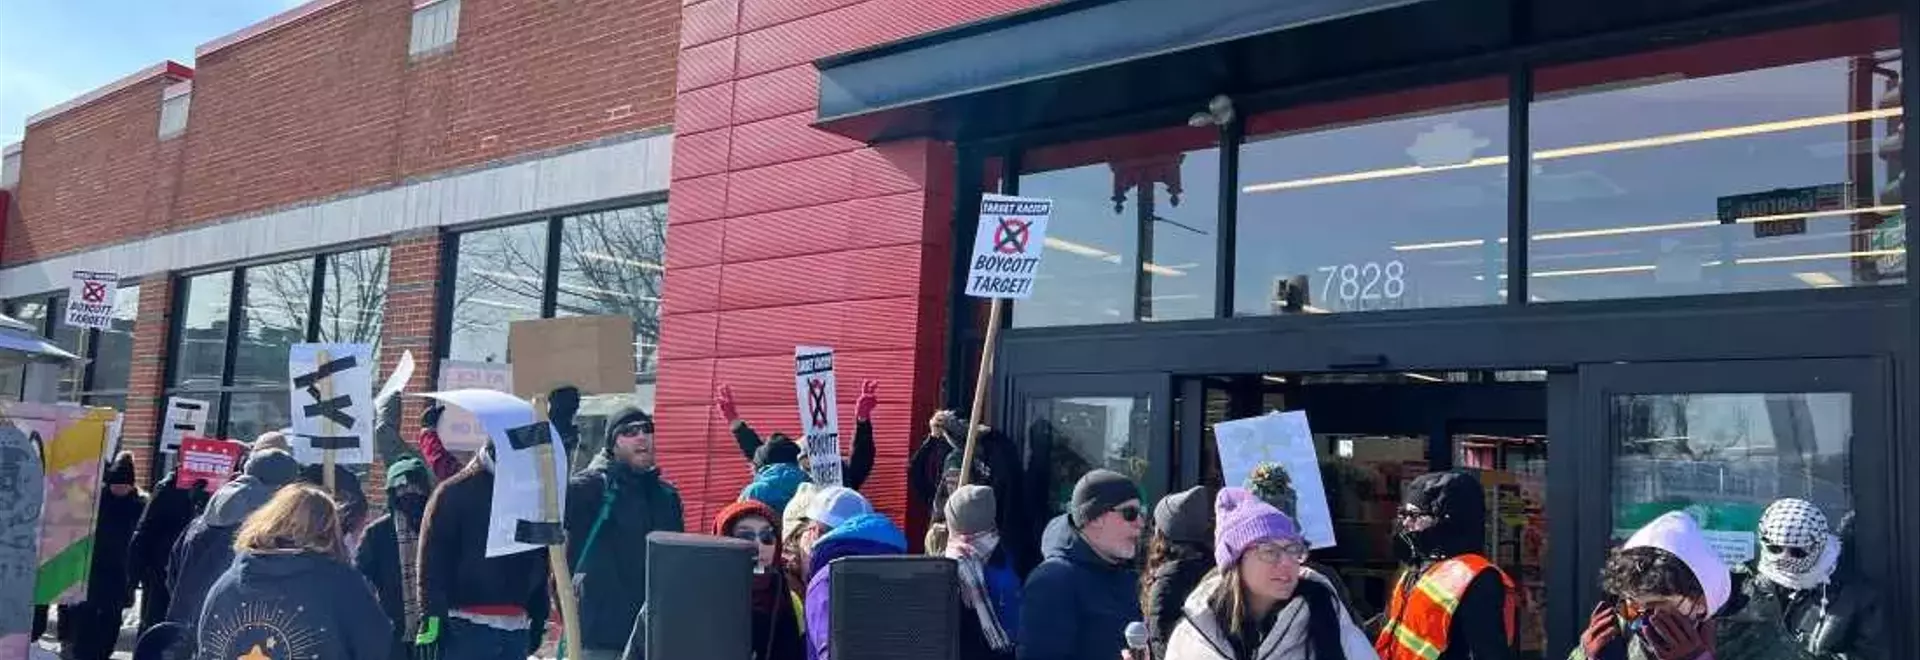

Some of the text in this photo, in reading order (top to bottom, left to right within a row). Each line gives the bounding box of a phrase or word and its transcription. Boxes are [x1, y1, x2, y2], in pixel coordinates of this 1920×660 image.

[974, 255, 1039, 274] BOYCOTT
[972, 276, 1032, 293] TARGET!
[1317, 260, 1404, 301] 7828
